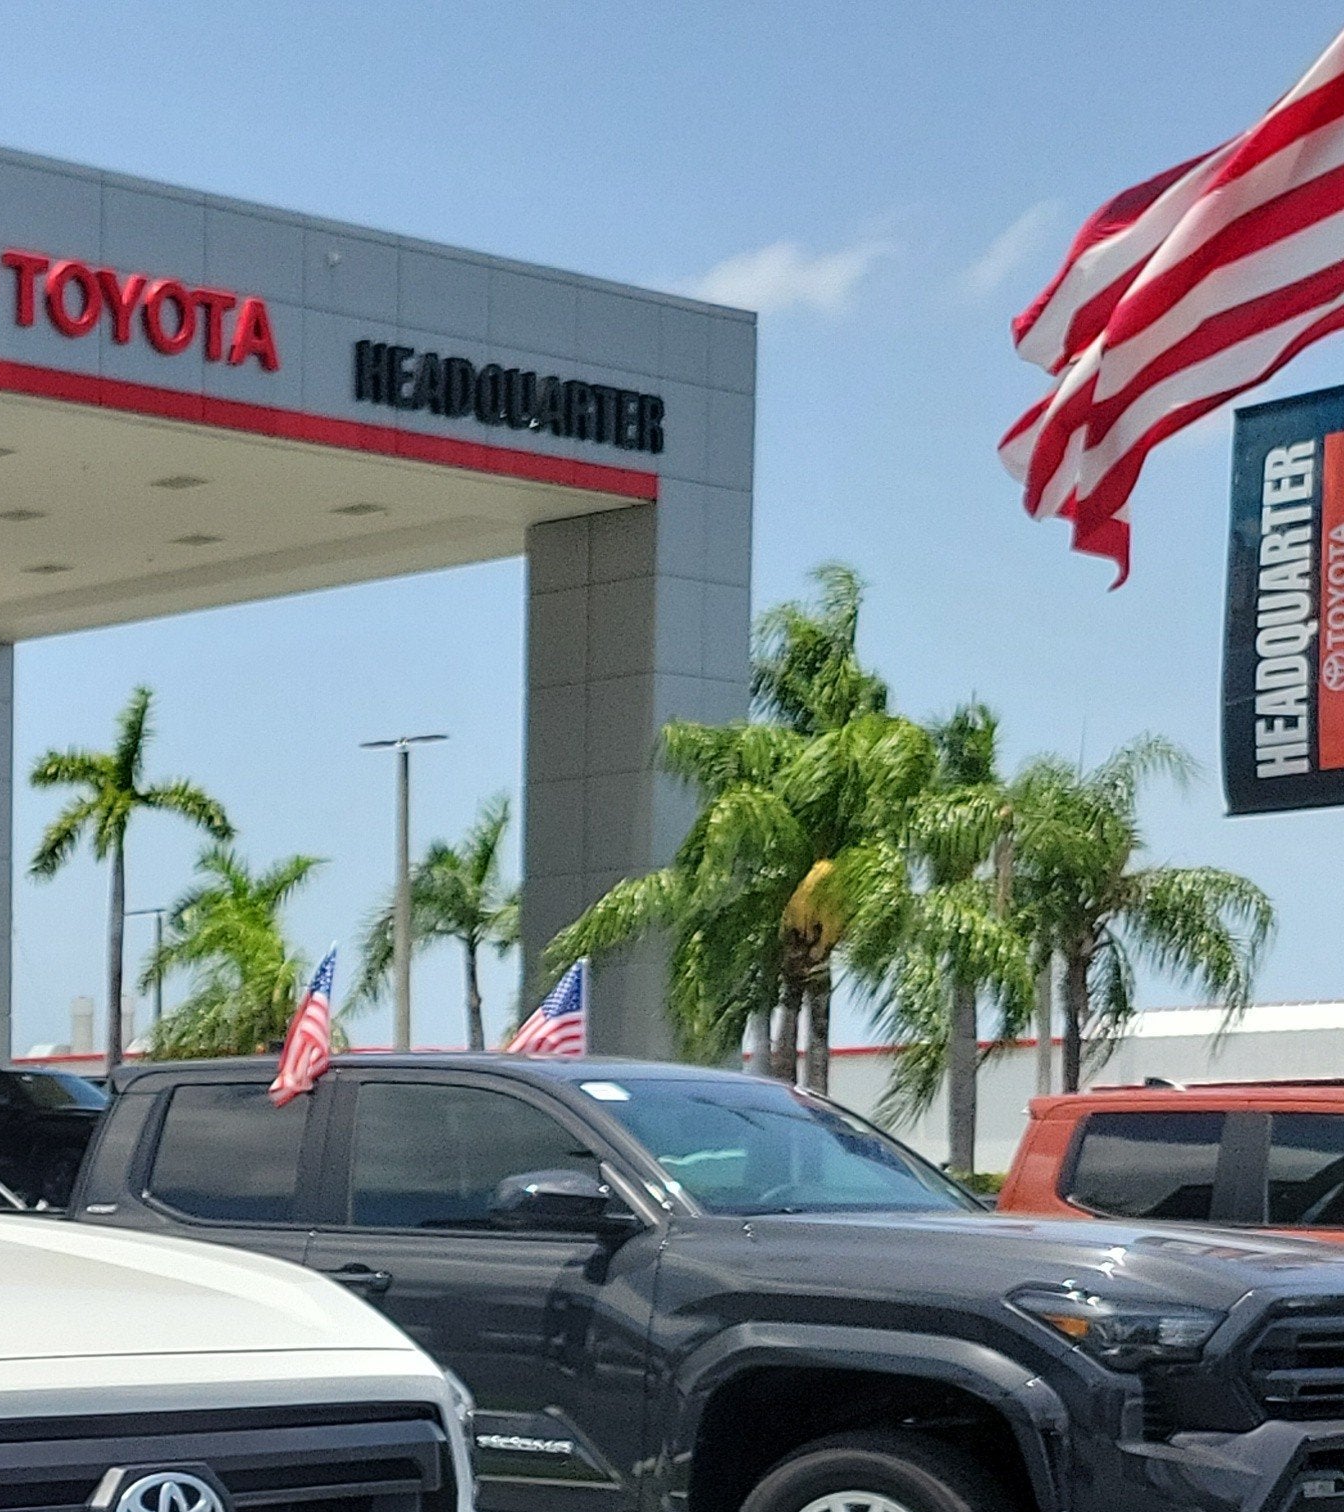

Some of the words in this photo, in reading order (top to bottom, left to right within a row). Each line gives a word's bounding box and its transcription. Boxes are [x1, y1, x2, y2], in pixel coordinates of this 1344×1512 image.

[1, 249, 281, 373] TOYOTA
[354, 339, 665, 454] HEADQUARTER
[1255, 438, 1319, 779] HEADQUARTER
